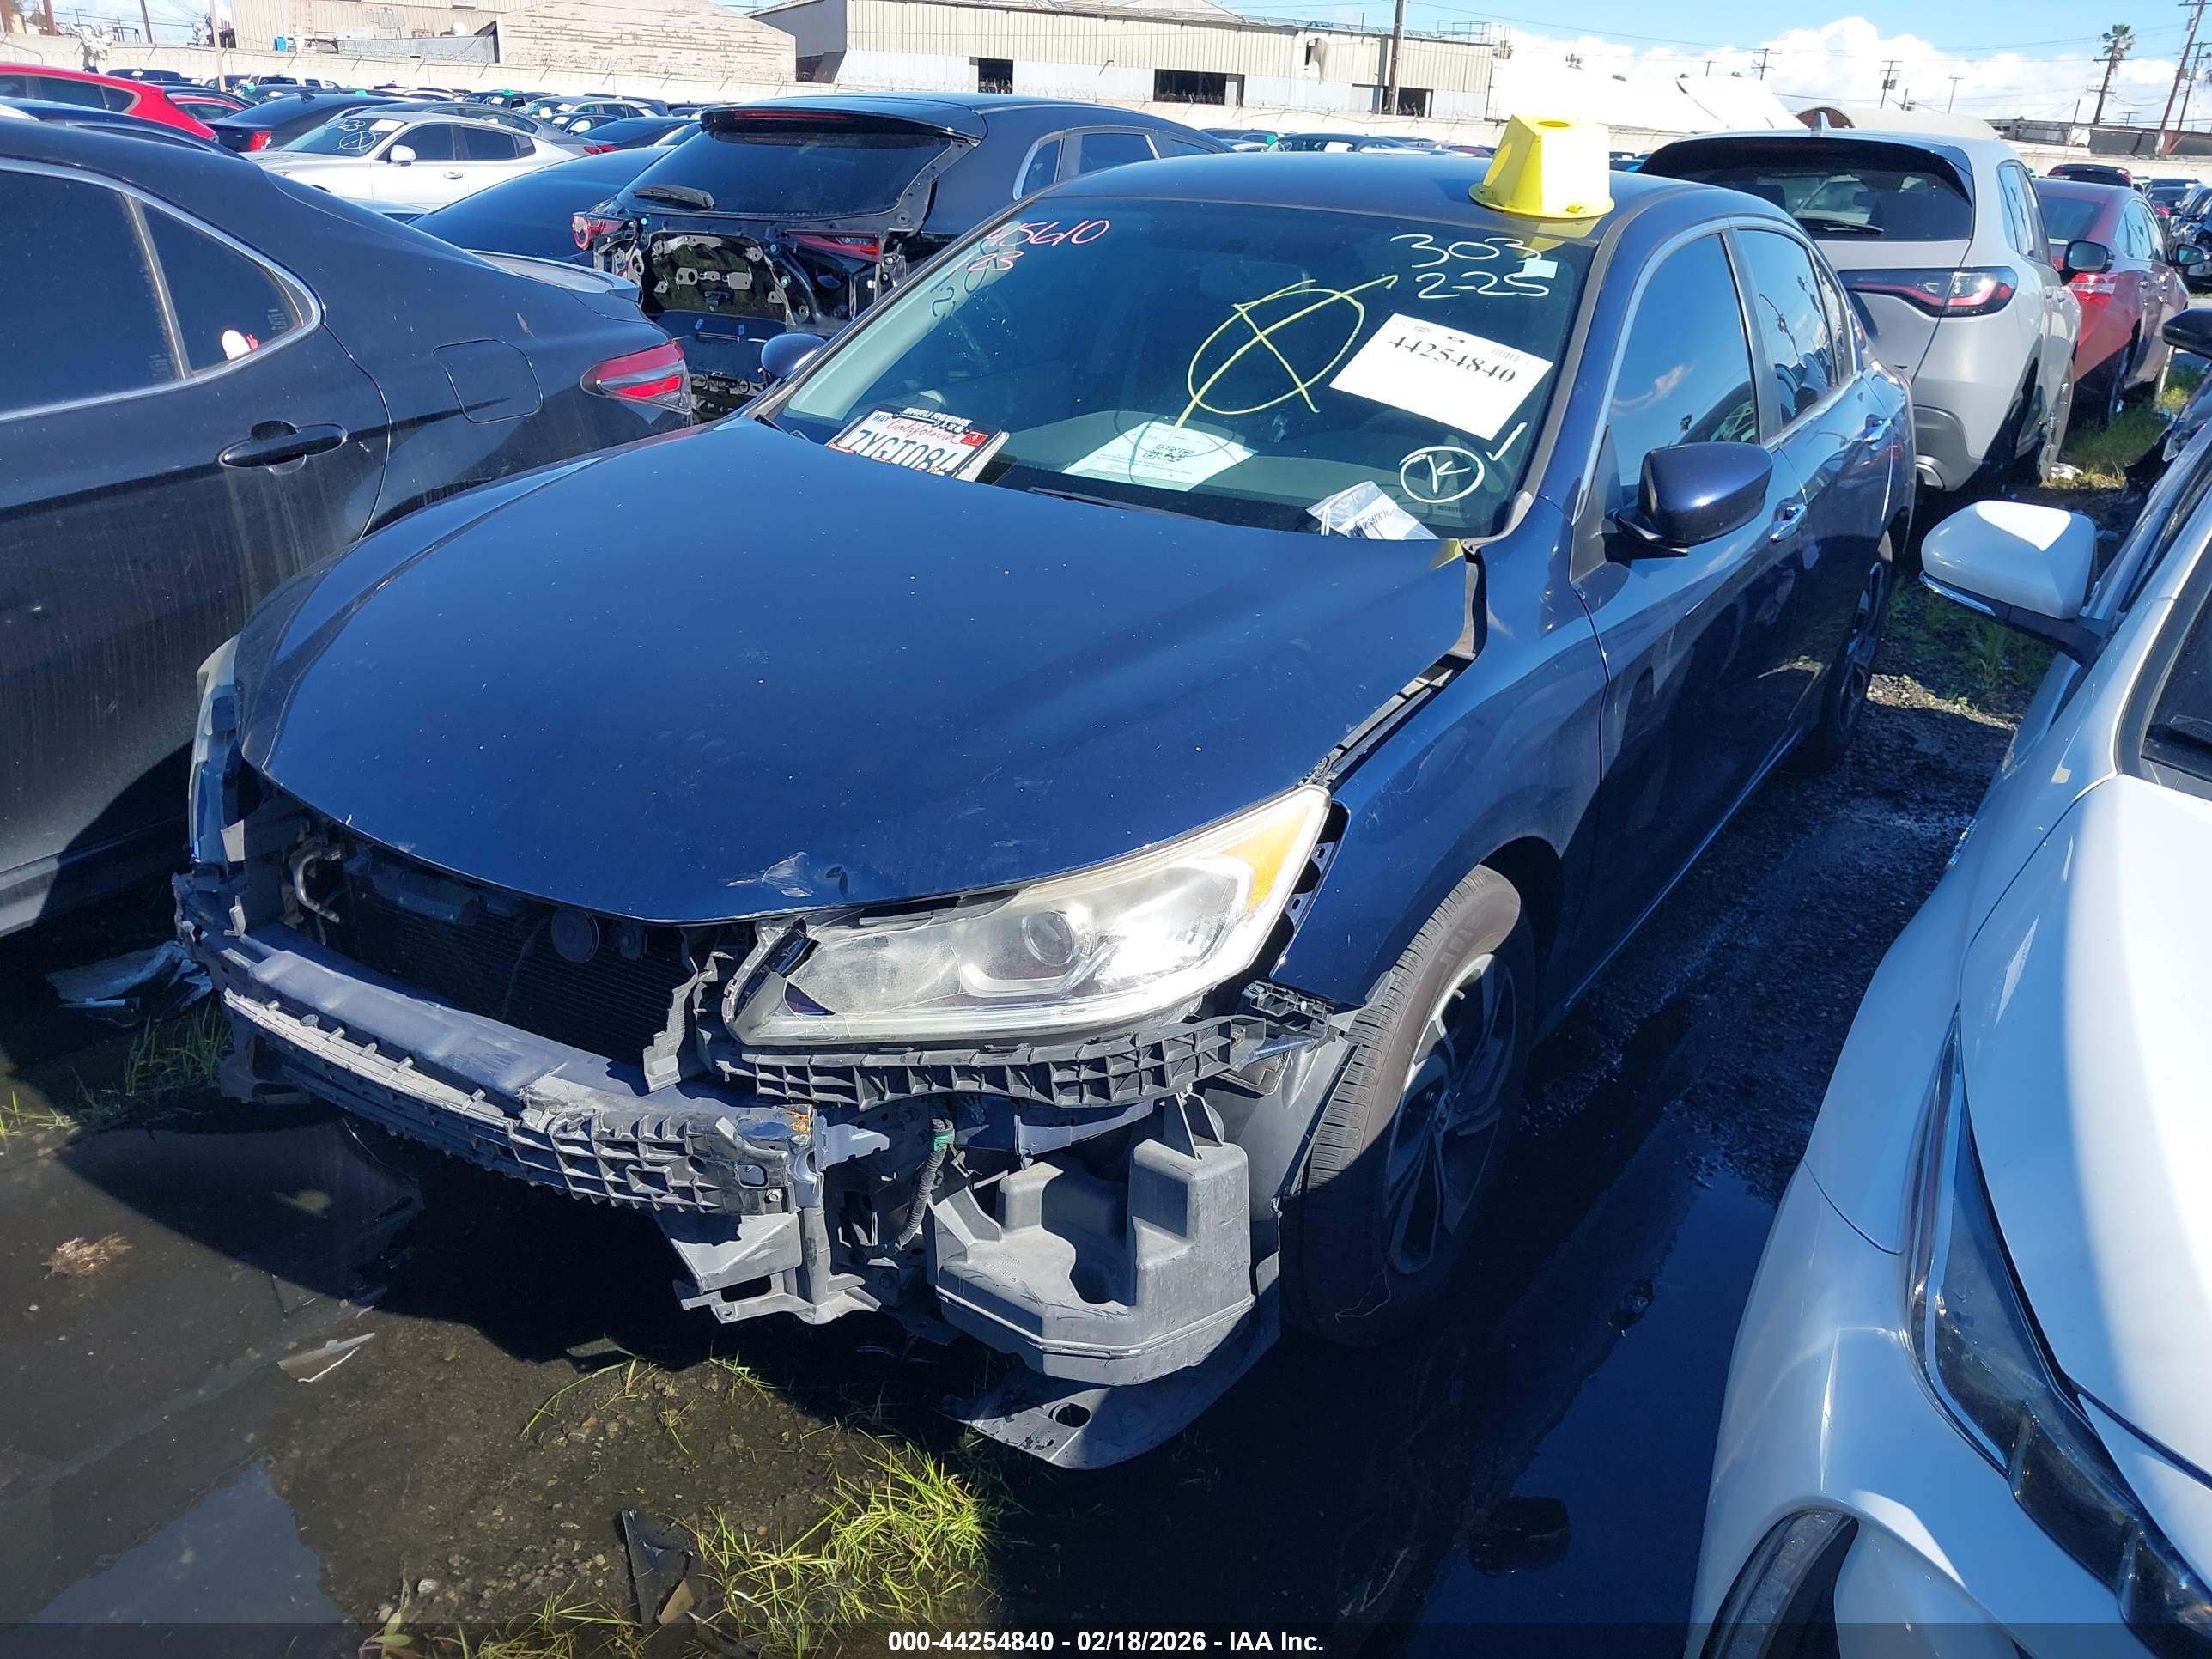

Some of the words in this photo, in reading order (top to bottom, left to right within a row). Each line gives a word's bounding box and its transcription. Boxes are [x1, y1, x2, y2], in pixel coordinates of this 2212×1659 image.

[1389, 234, 1543, 268] 303
[1388, 336, 1516, 383] 44254840
[886, 419, 963, 445] California
